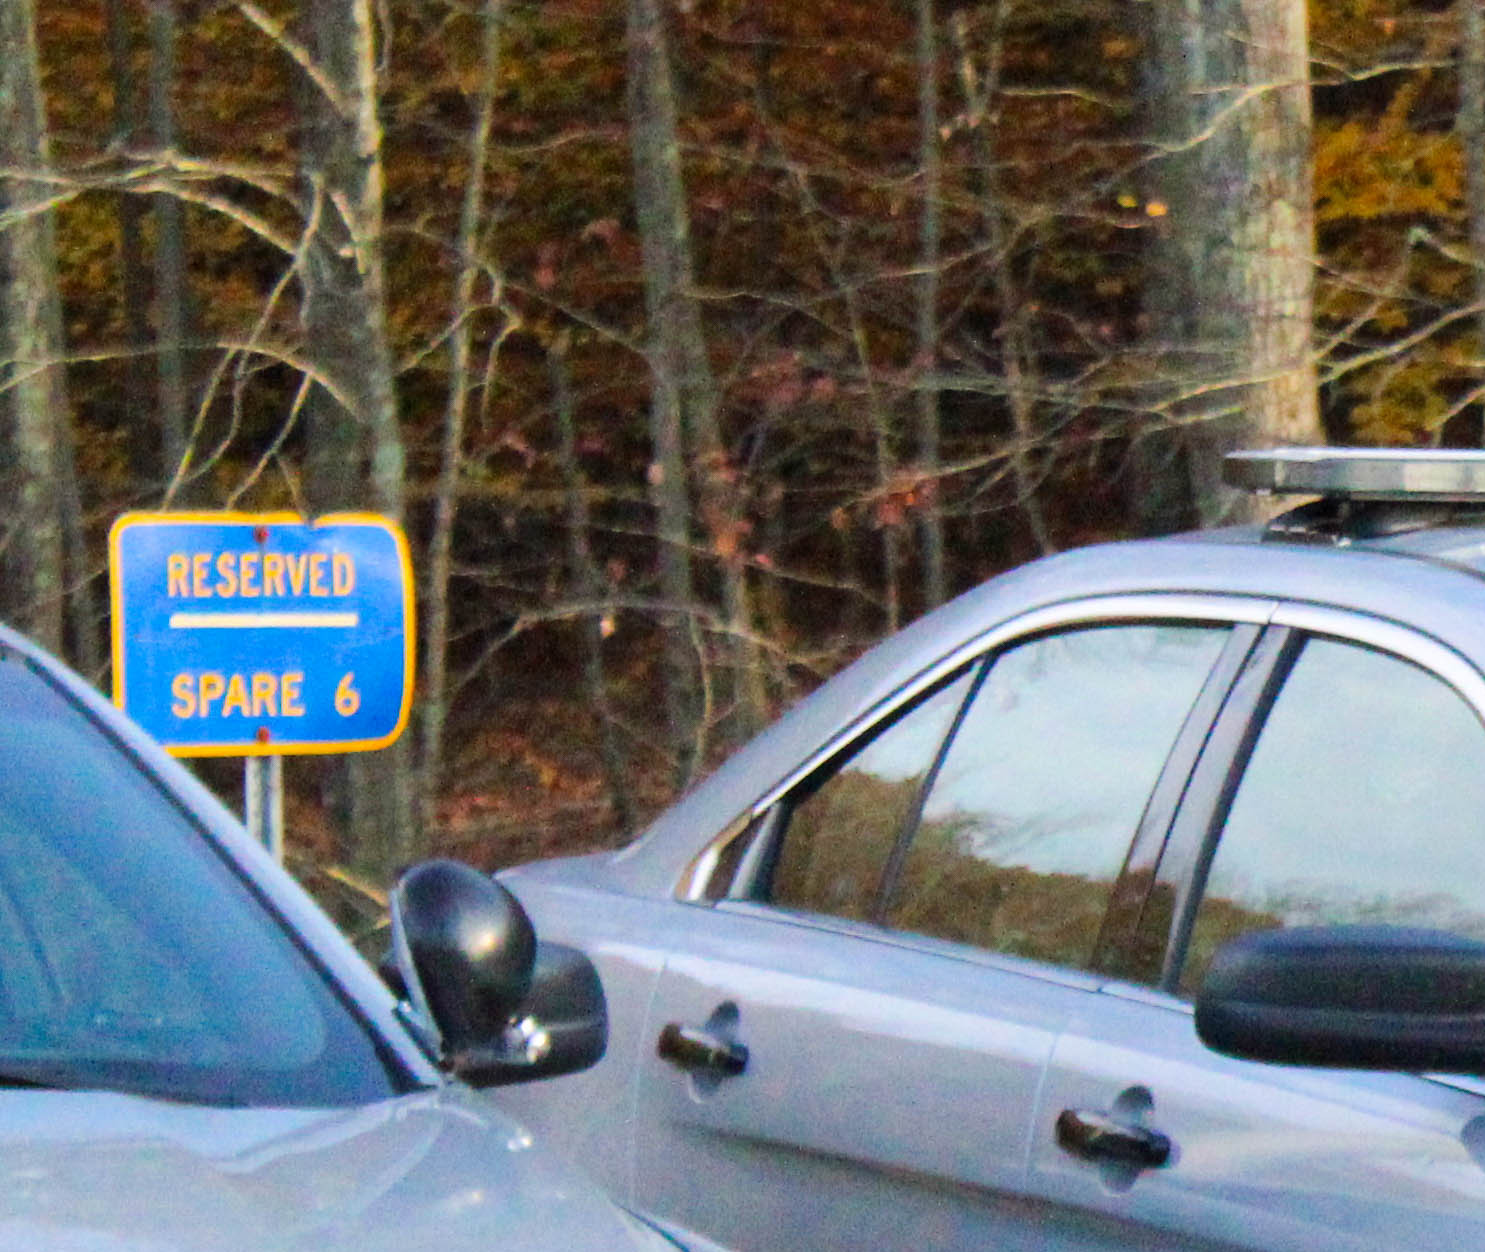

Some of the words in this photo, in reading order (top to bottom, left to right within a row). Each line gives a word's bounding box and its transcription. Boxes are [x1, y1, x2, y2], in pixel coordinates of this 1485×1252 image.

[166, 553, 355, 598] RESERVED
[171, 672, 305, 718] SPARE
[334, 672, 361, 717] 6
